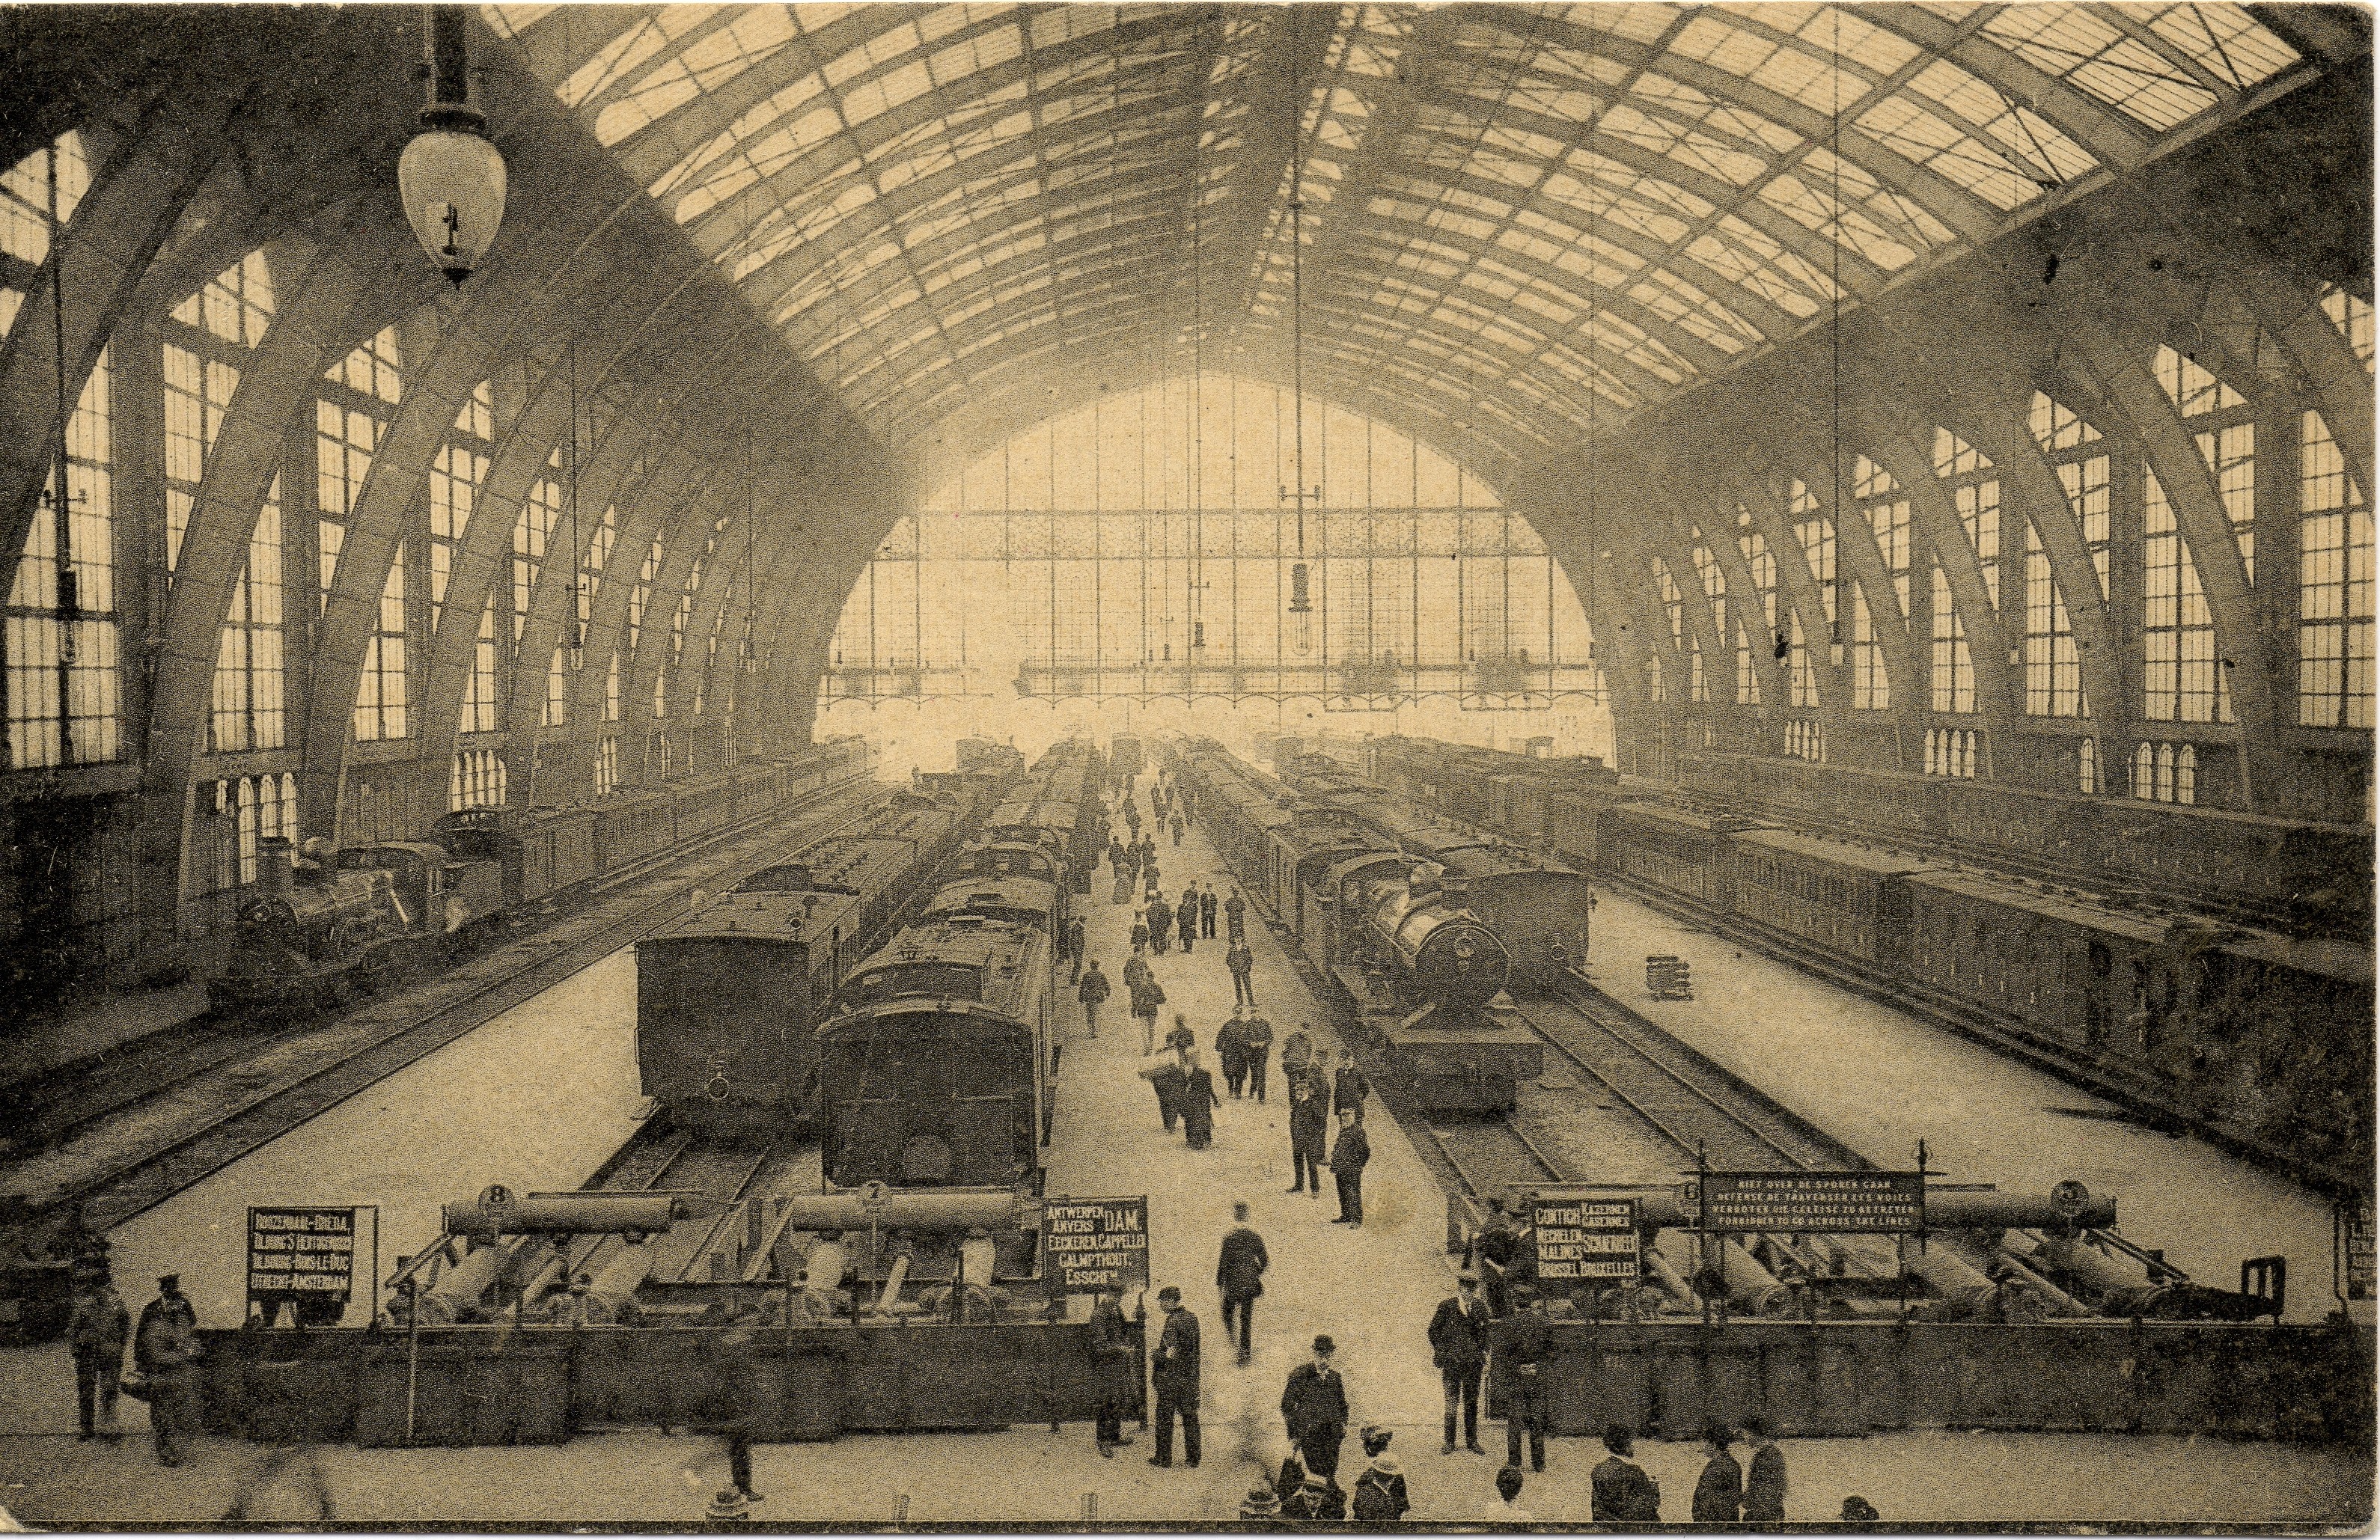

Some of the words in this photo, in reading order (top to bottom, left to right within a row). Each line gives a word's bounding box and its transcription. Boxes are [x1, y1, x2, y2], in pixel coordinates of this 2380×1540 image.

[867, 1182, 881, 1199] 7
[1684, 1183, 1699, 1200] 6
[1738, 1179, 1762, 1189] NIET
[1766, 1179, 1793, 1189] OVER
[1798, 1179, 1811, 1189] DE
[1816, 1179, 1858, 1189] SPOREN
[489, 1185, 506, 1203] 8
[1766, 1192, 1780, 1202] DE
[1784, 1192, 1848, 1202] TRAVERSER
[1852, 1192, 1873, 1202] LES
[1876, 1192, 1911, 1202] VOIES
[1047, 1206, 1104, 1220] ANTWERPEN
[1535, 1207, 1581, 1226] CONTICH
[1712, 1205, 1769, 1214] VERBOTEN
[1772, 1205, 1789, 1214] DIE
[1858, 1205, 1914, 1214] BETRETEN
[1052, 1219, 1094, 1233] ANVERS
[1718, 1216, 1775, 1226] FORBIDDEN
[1778, 1216, 1790, 1226] TO
[1808, 1216, 1850, 1226] ACROSS
[1855, 1216, 1876, 1226] THE
[1879, 1216, 1911, 1226] LINES
[1538, 1243, 1583, 1260] MALINES
[1538, 1260, 1579, 1277] BRUSSEL
[1580, 1259, 1635, 1277] BRUXELLES
